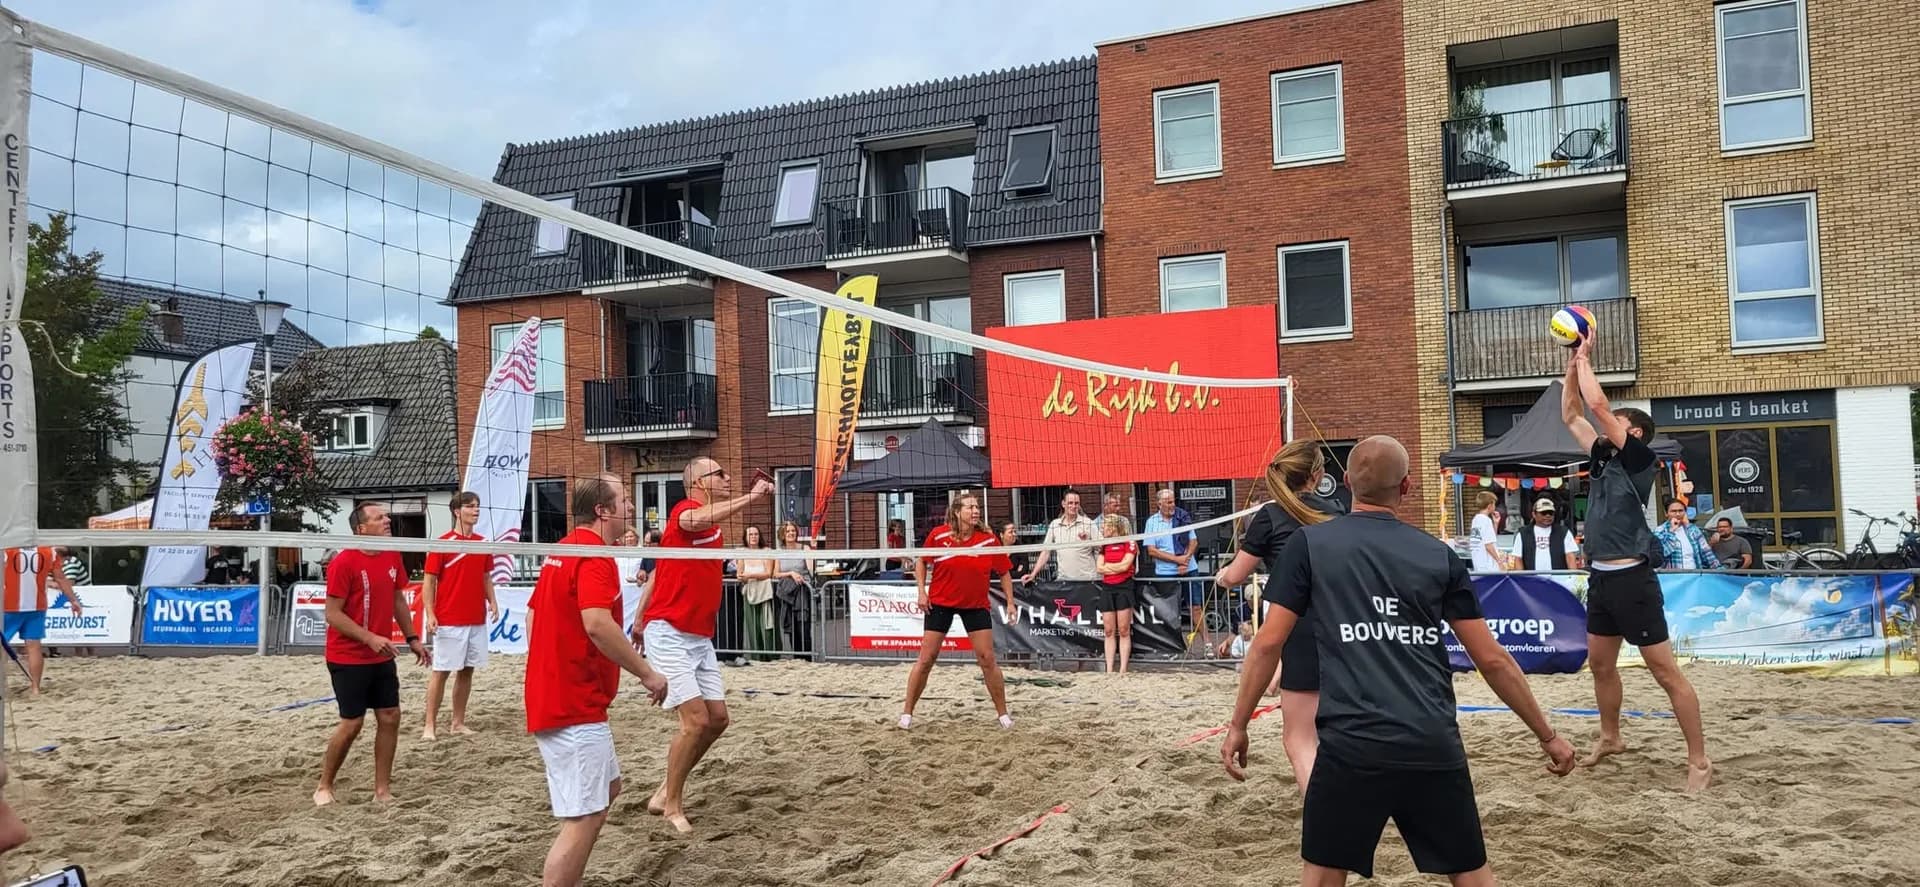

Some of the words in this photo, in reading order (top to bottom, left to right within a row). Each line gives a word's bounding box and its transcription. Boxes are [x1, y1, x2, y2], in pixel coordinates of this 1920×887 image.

[1042, 370, 1078, 419] de
[1674, 404, 1723, 420] brood
[1731, 400, 1742, 417] &
[1749, 398, 1809, 416] banket
[153, 599, 233, 622] HUYER
[858, 599, 923, 615] SPAARG
[1372, 596, 1399, 616] DE
[45, 616, 107, 629] GERVORST
[489, 608, 522, 643] de
[1030, 628, 1075, 637] MARKETING
